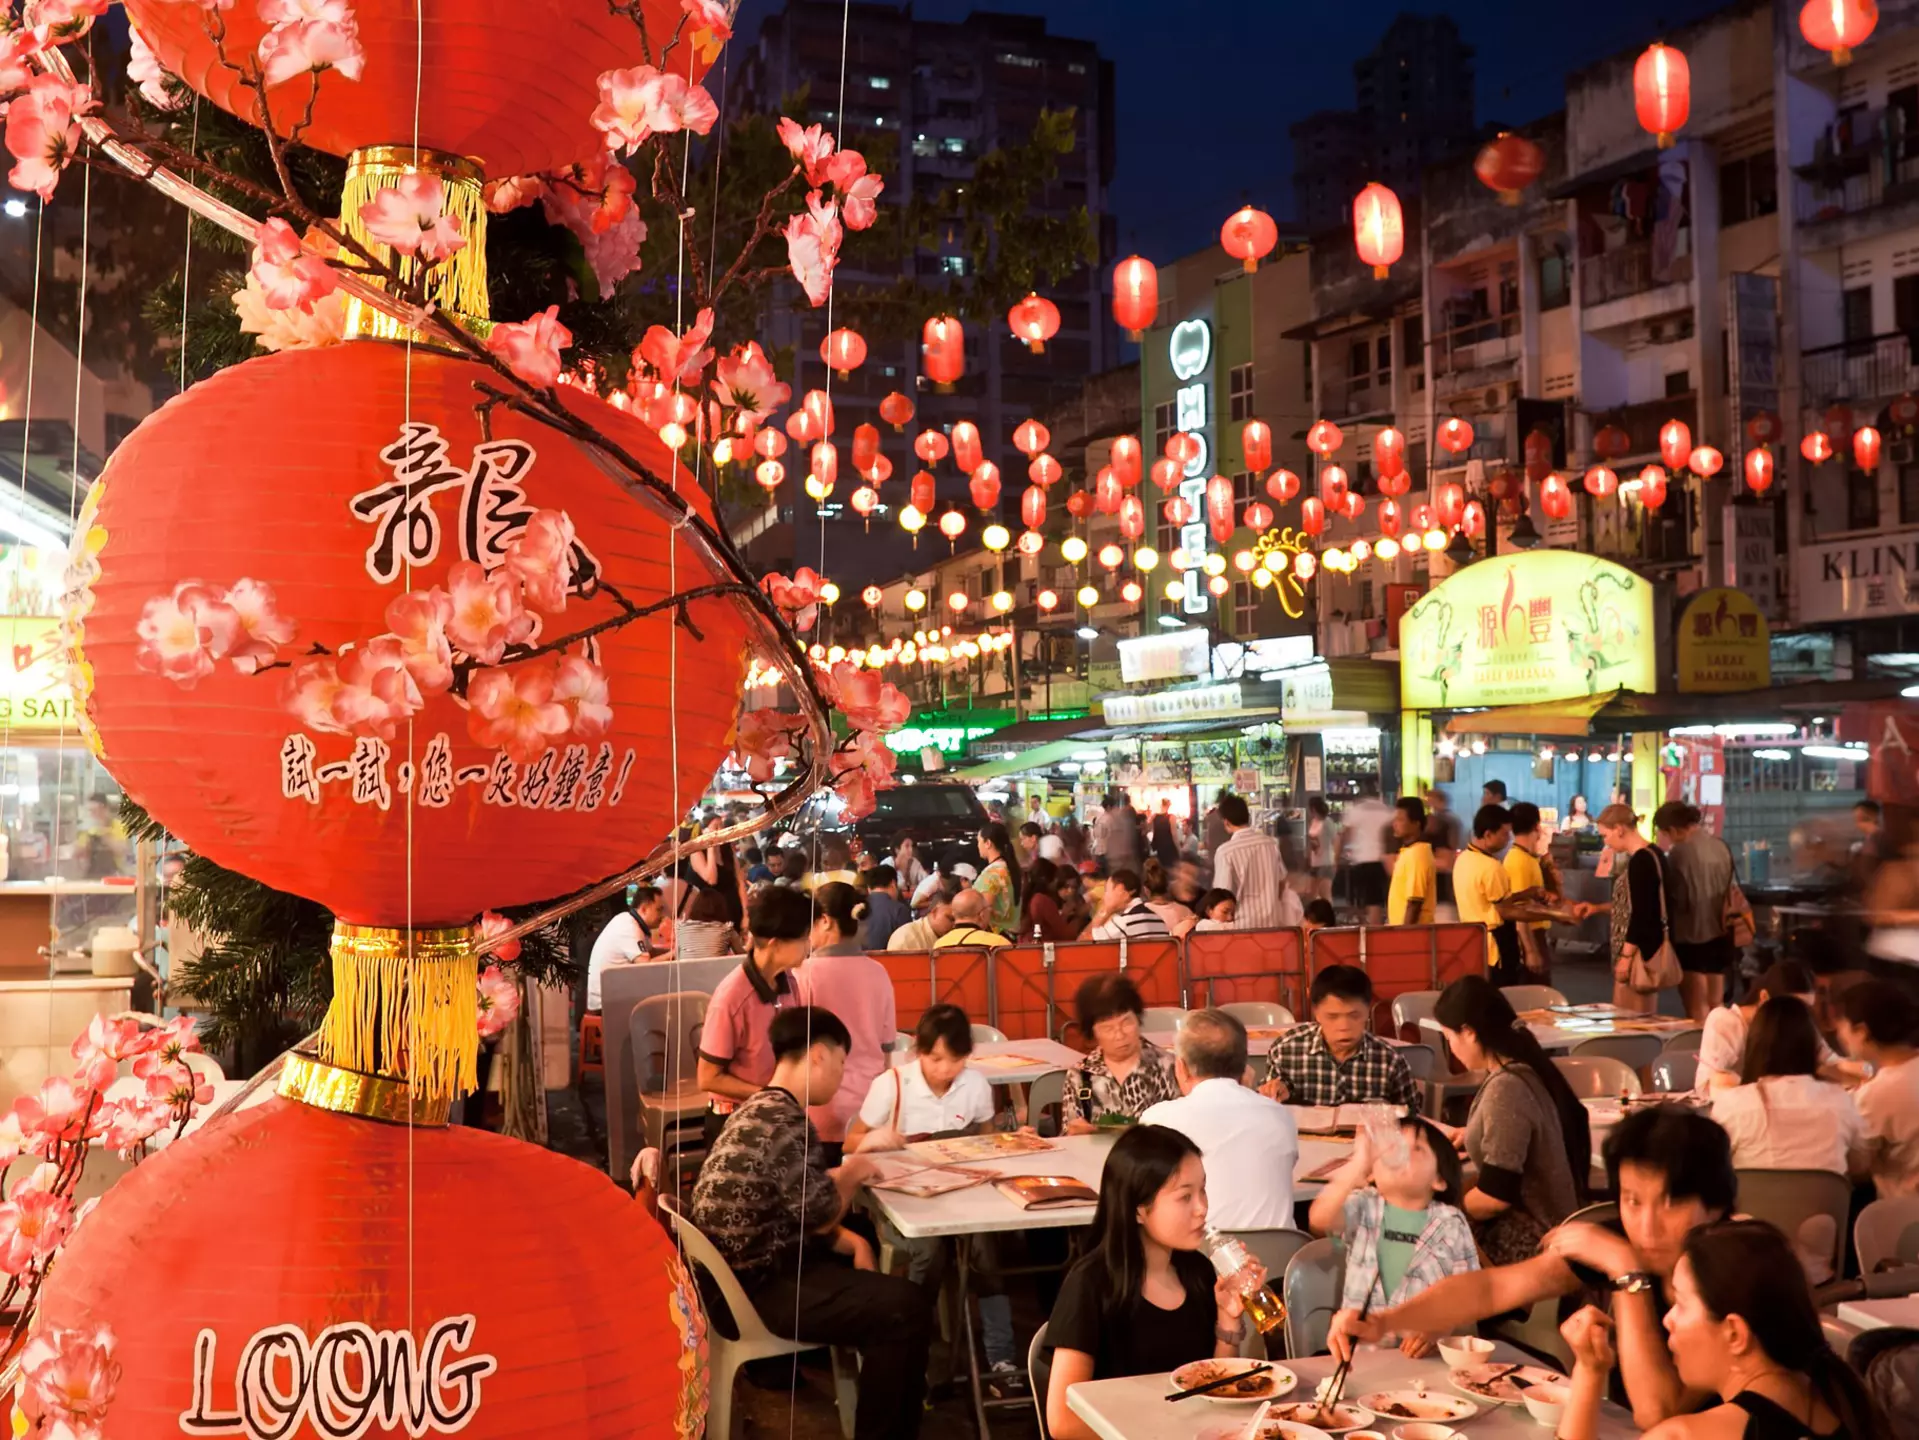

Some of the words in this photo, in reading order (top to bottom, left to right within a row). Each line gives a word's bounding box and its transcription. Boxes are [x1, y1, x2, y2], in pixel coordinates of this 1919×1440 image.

[1176, 383, 1209, 615] HOTEL
[23, 698, 76, 717] SAT
[186, 1320, 490, 1440] LOONG
